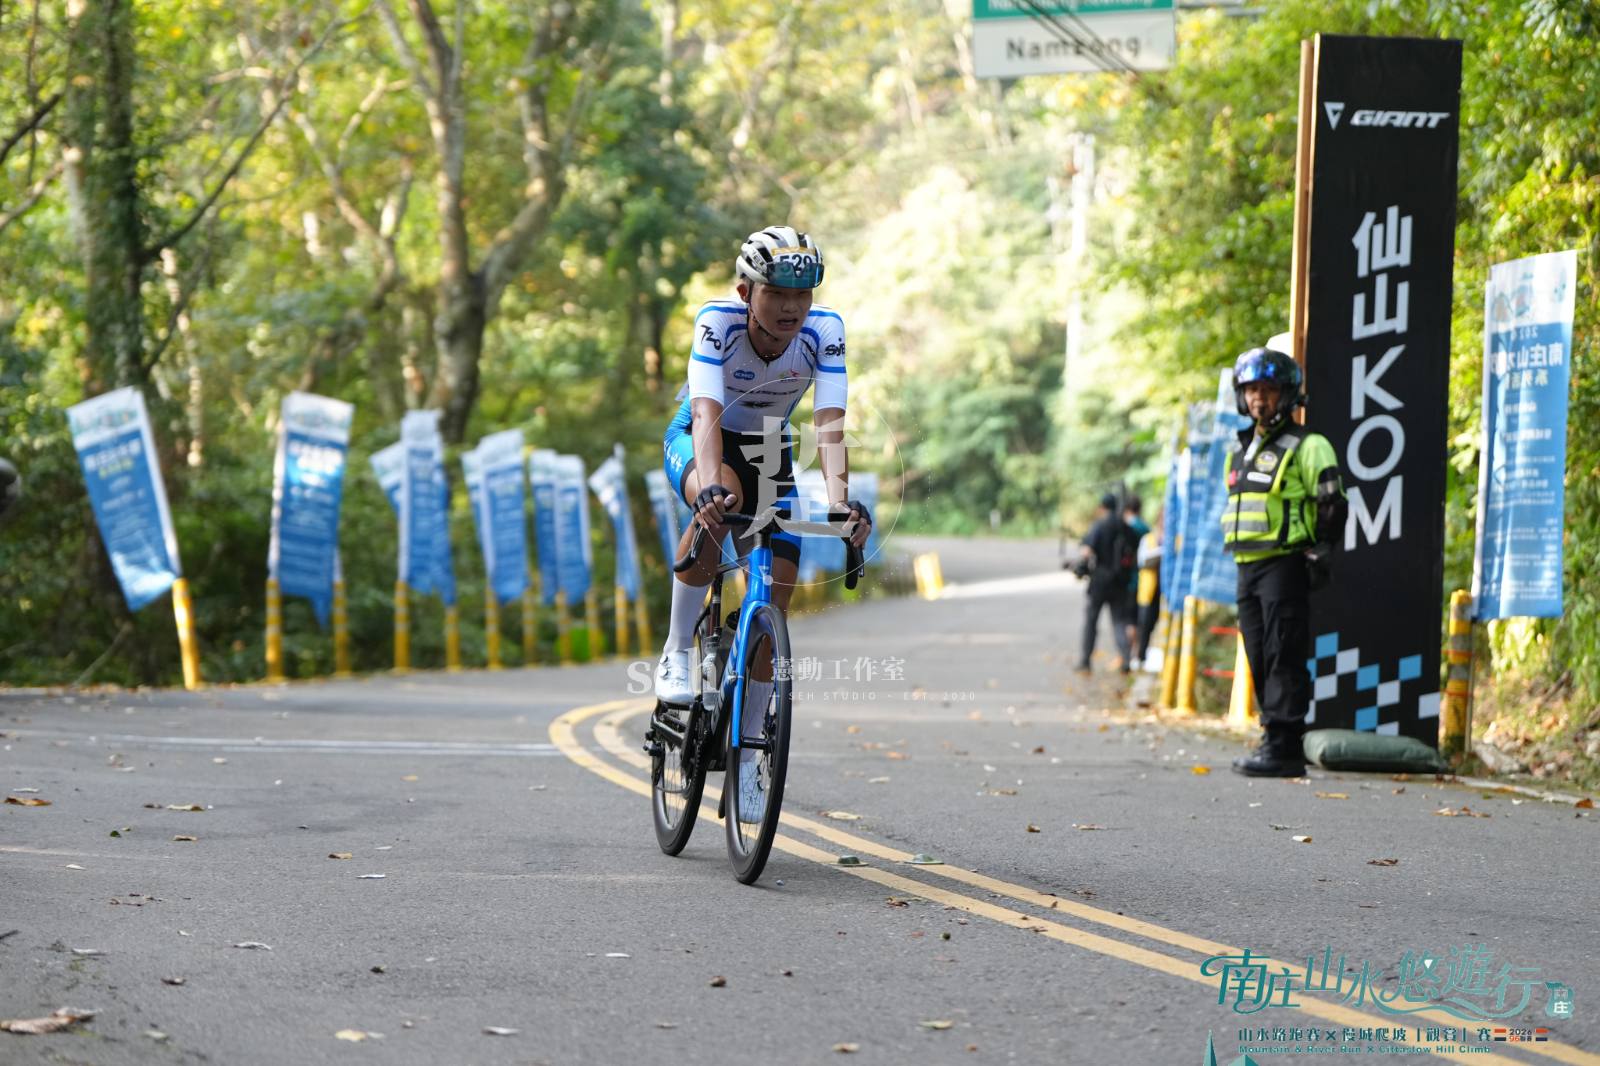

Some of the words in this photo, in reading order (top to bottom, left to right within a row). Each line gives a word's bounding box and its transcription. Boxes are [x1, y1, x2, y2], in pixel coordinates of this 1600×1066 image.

[1350, 109, 1450, 128] GIANT
[1351, 204, 1413, 341] 仙山
[1344, 344, 1406, 551] KOM
